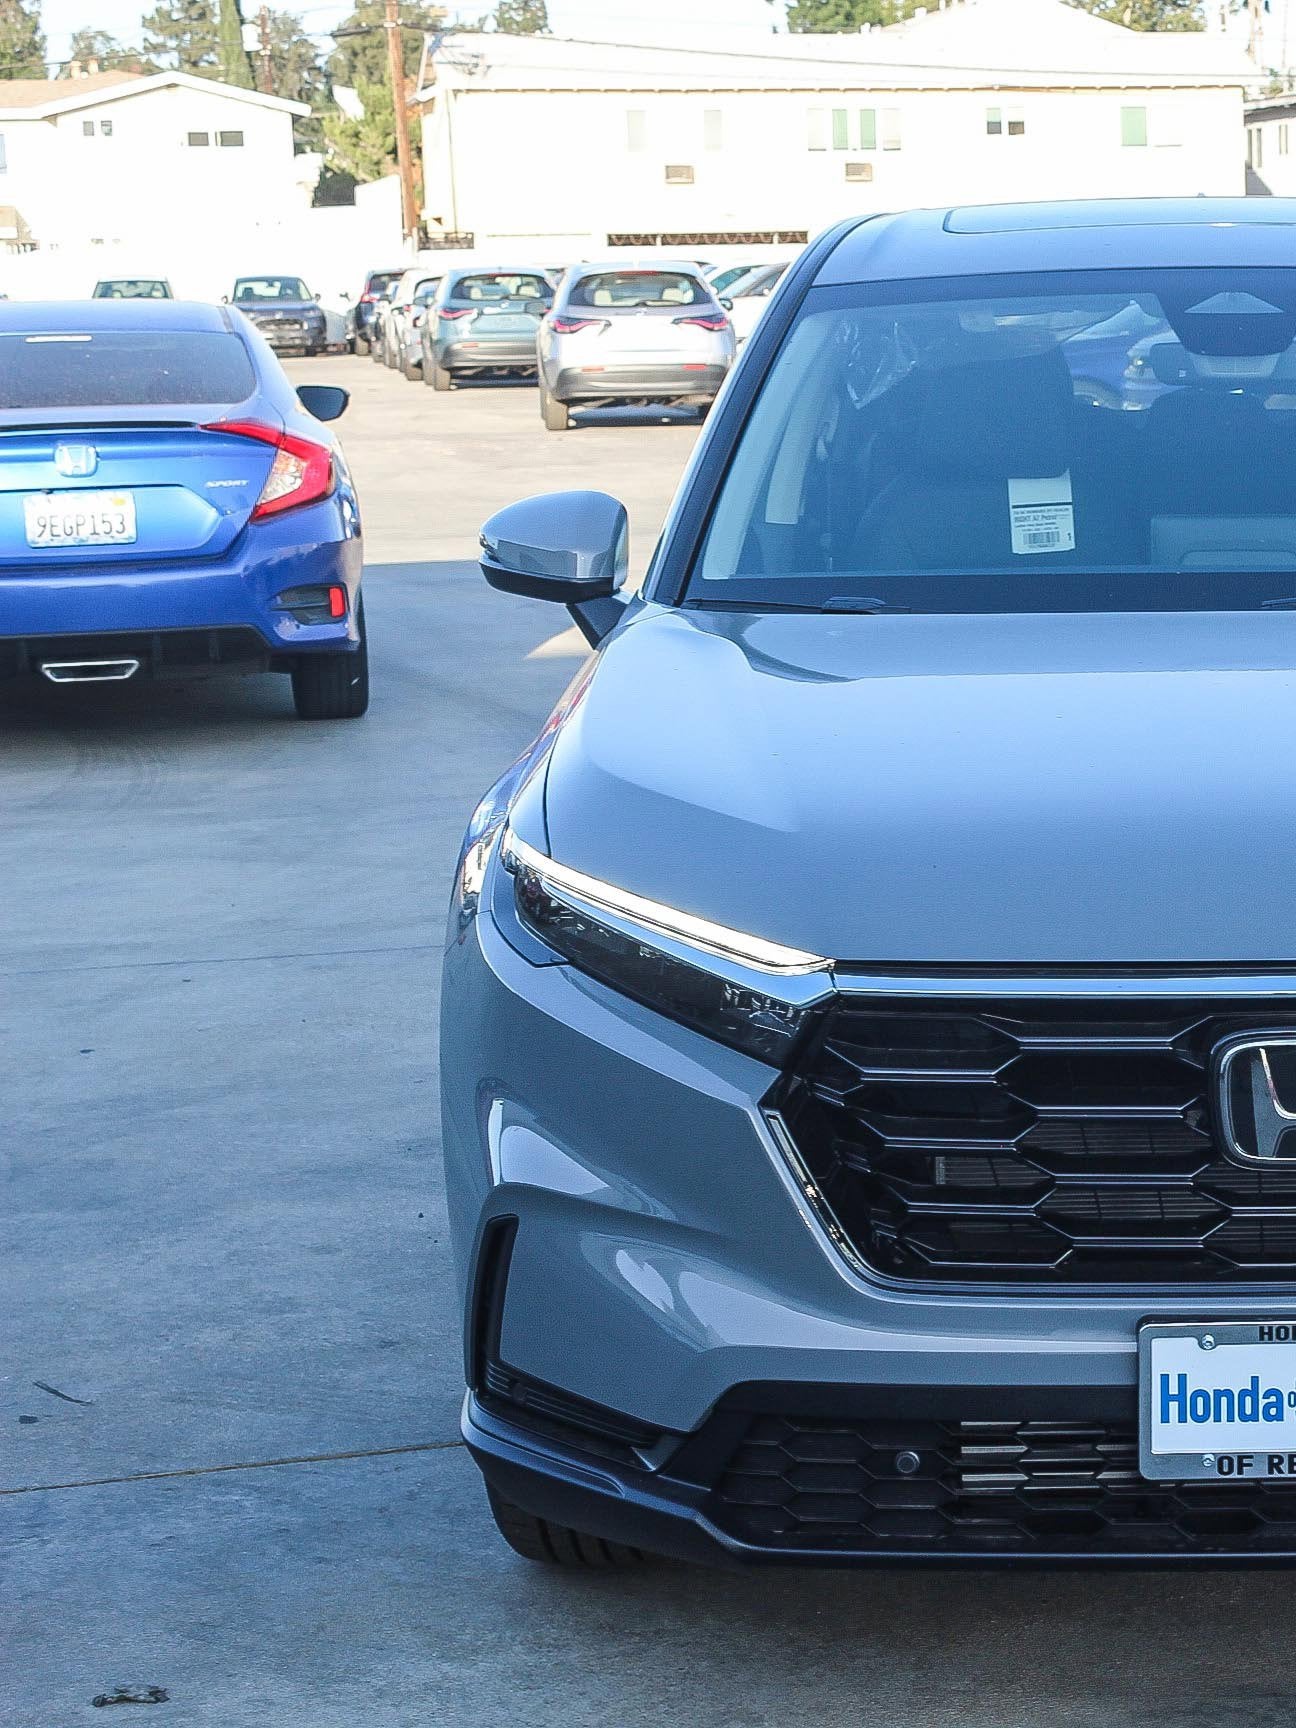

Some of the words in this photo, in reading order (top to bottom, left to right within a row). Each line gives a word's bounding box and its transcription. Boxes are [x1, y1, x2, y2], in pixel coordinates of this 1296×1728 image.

[37, 513, 126, 538] 9EGP153
[1160, 1373, 1284, 1424] Honda
[1217, 1455, 1254, 1476] OF
